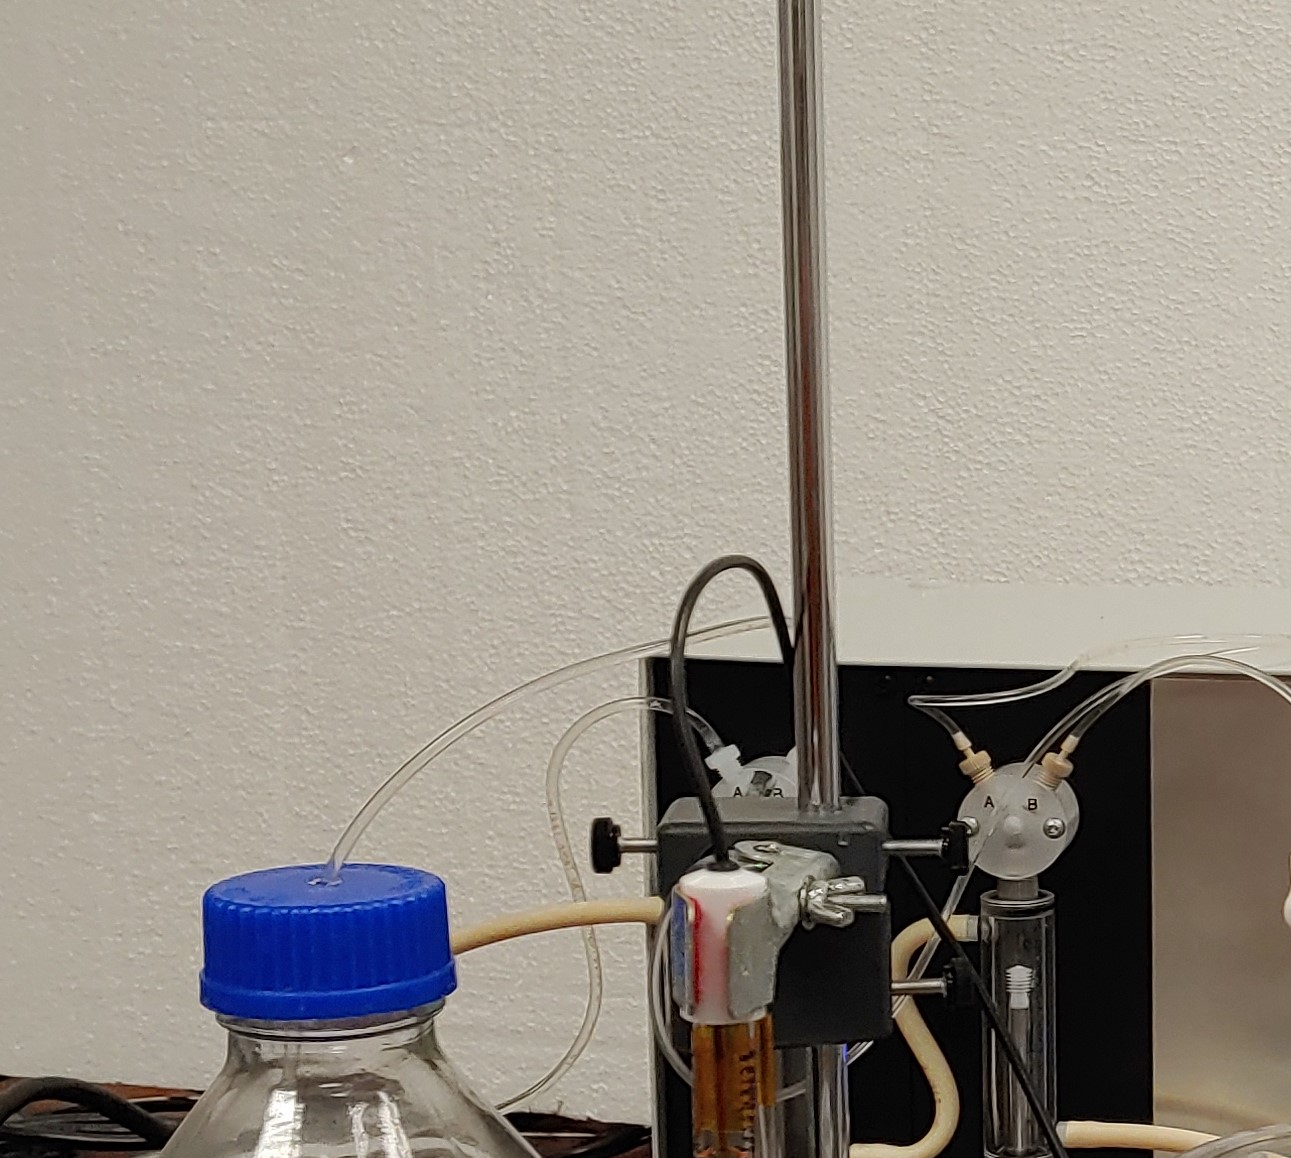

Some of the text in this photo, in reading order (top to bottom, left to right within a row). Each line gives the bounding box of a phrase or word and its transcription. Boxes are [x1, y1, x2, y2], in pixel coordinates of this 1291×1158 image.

[733, 786, 743, 798] A
[983, 796, 1039, 811] A B
